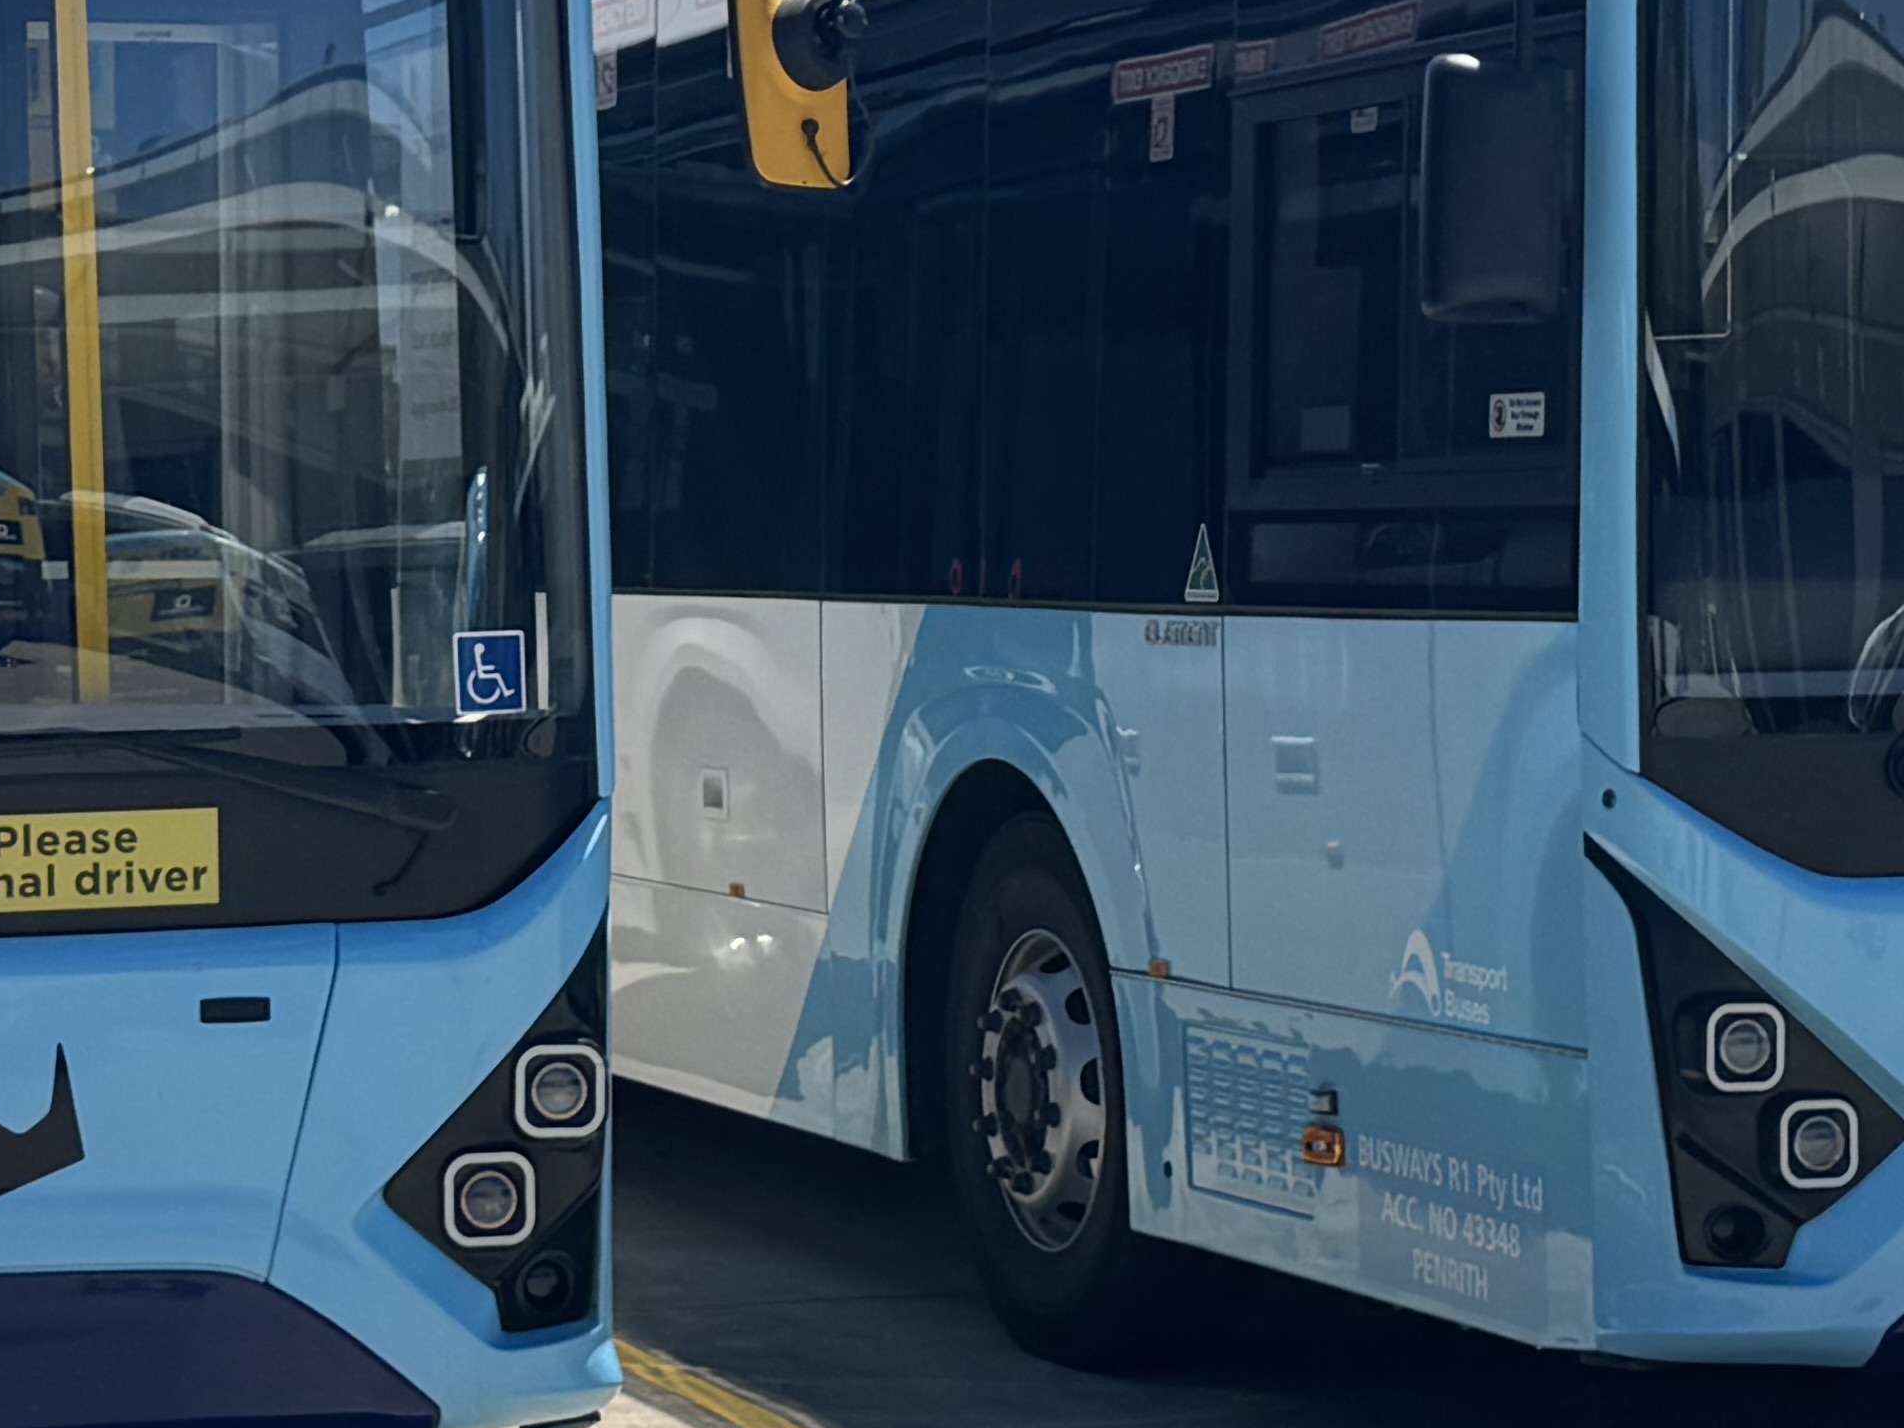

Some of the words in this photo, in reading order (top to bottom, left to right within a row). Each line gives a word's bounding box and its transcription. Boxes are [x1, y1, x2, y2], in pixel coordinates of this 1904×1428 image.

[67, 859, 209, 898] driver
[1441, 951, 1508, 992] Transport
[1444, 990, 1491, 1025] Buses
[1358, 1135, 1443, 1190] BUSWAYS
[1448, 1158, 1471, 1193] R1
[1476, 1170, 1511, 1211] Pty
[1513, 1173, 1543, 1212] Ltd
[1381, 1191, 1424, 1230] ACC.
[1429, 1204, 1459, 1240] NO
[1463, 1214, 1522, 1259] 43348
[1412, 1248, 1490, 1301] PENRITH
